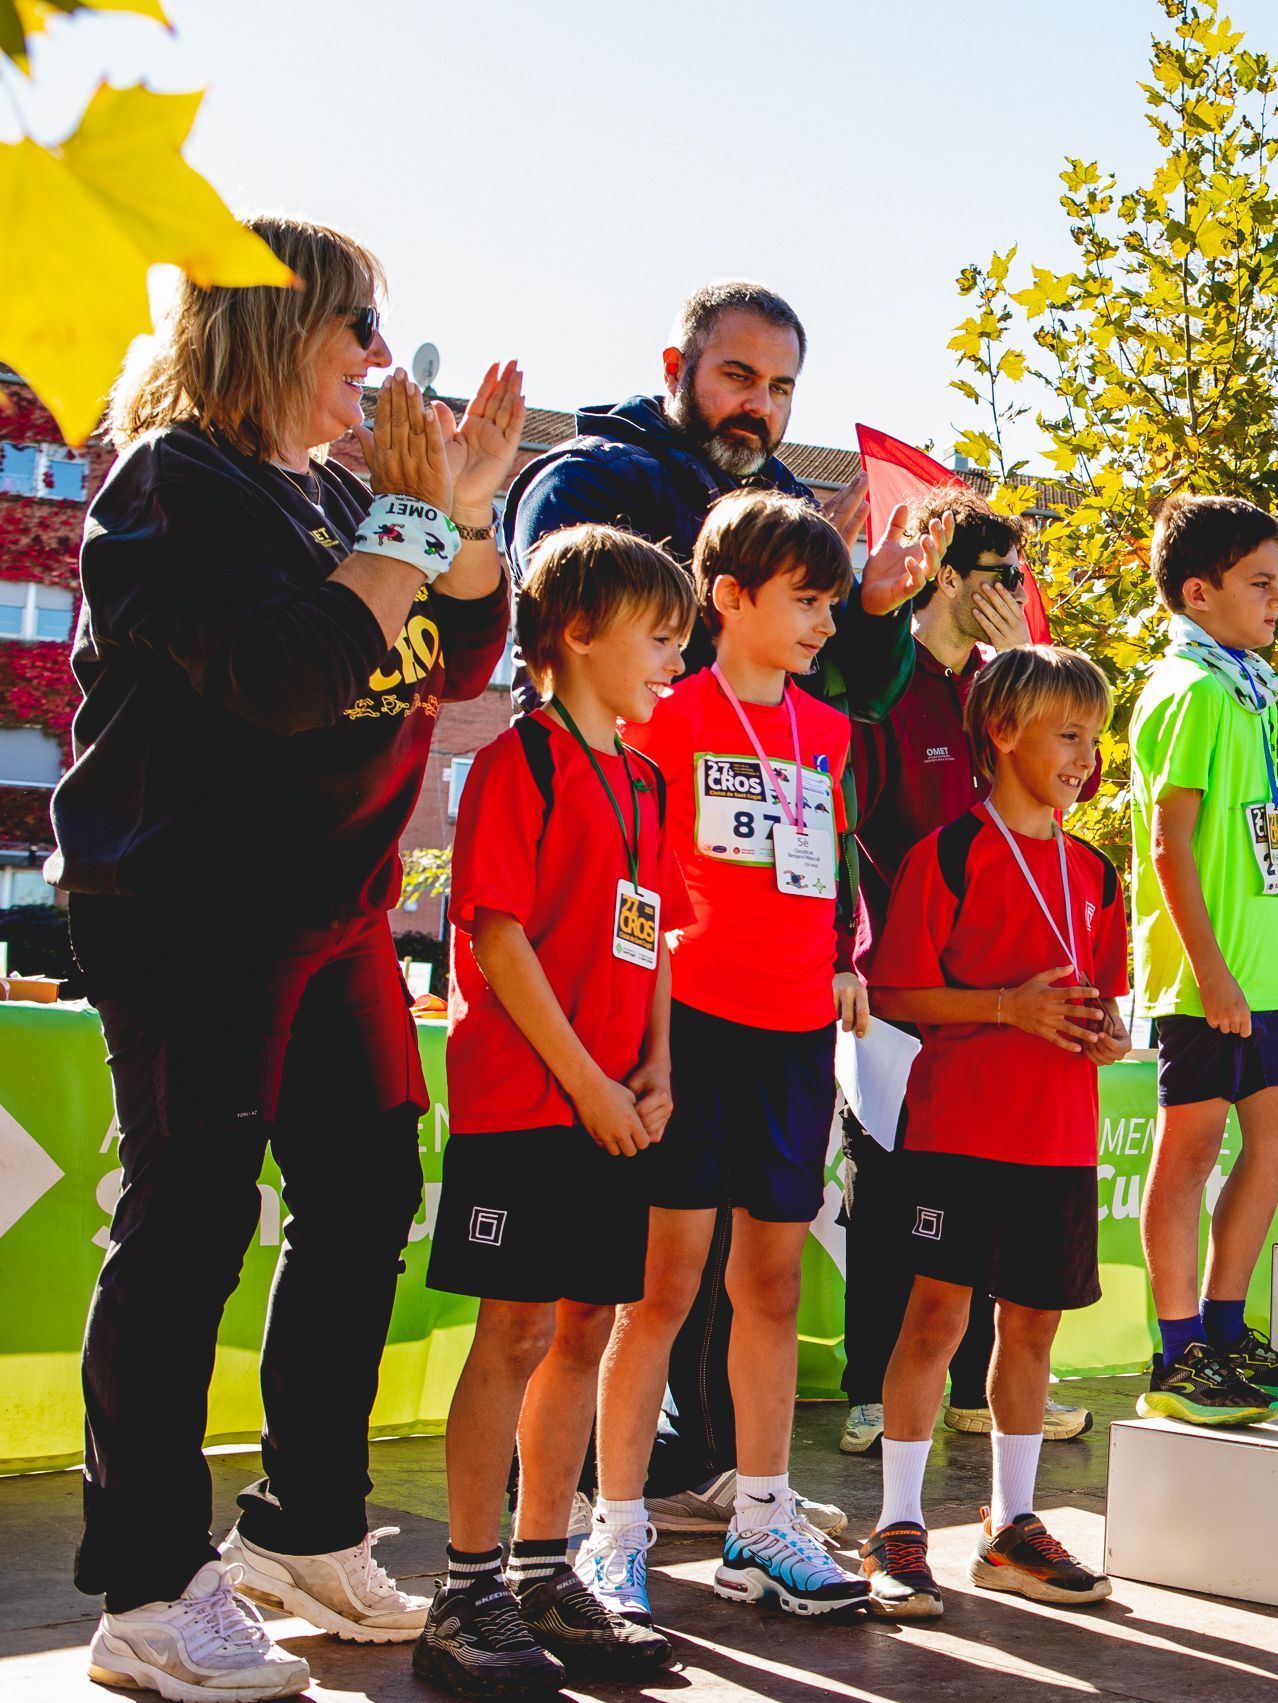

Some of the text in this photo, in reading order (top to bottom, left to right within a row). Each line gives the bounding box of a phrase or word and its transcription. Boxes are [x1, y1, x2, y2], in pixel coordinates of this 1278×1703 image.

[386, 502, 438, 521] OMET
[926, 747, 949, 756] OMET
[707, 774, 763, 795] CROS
[619, 911, 655, 943] CROS
